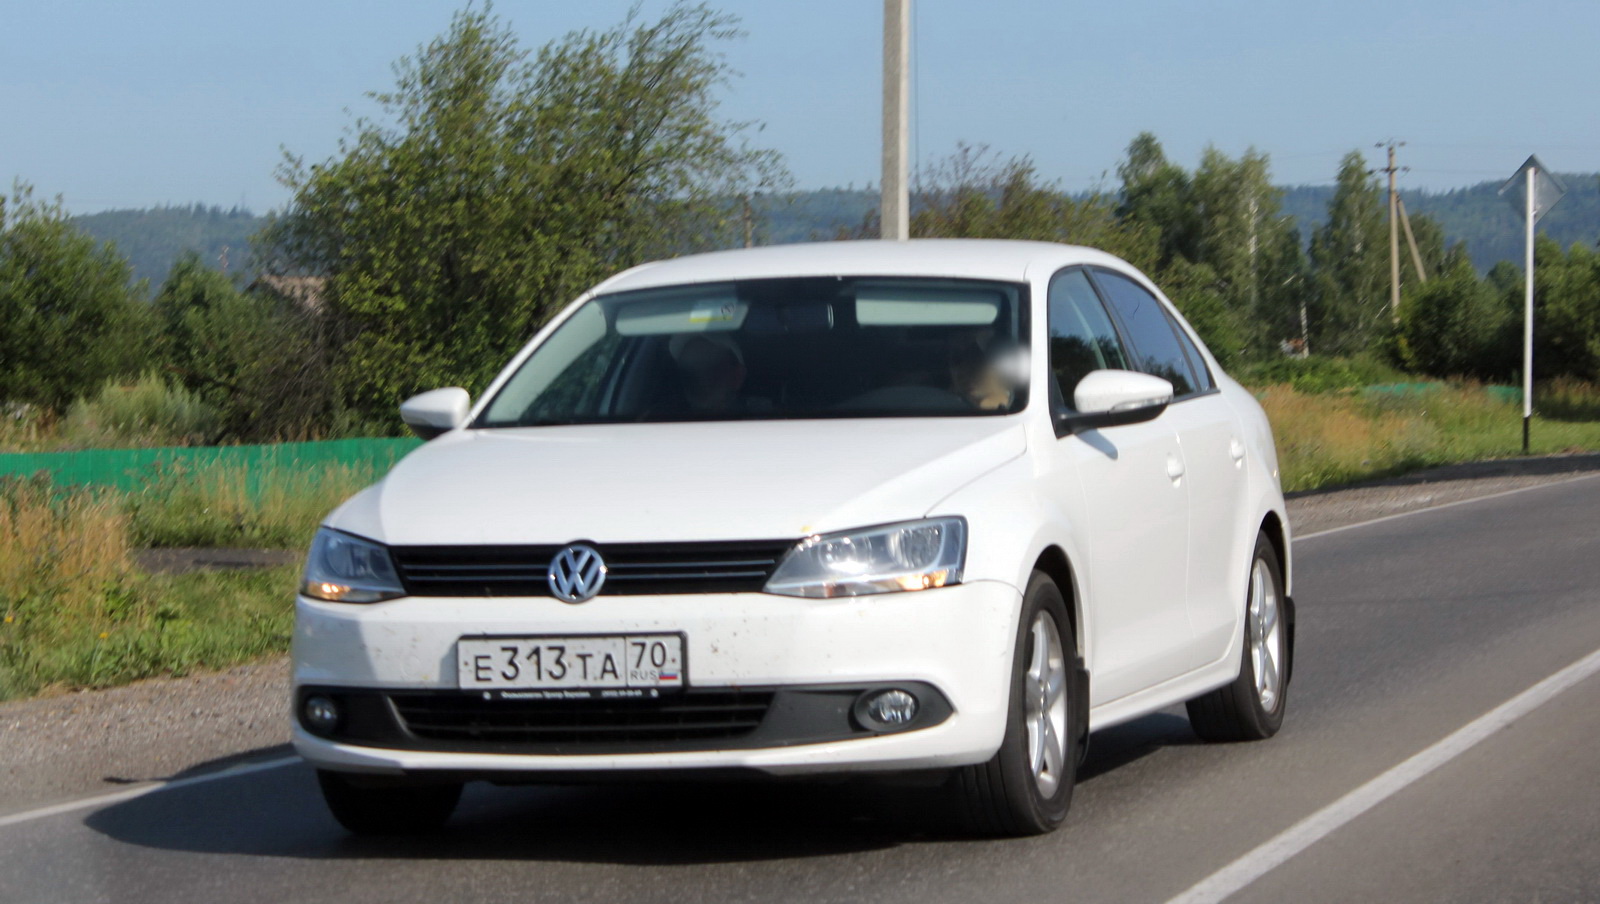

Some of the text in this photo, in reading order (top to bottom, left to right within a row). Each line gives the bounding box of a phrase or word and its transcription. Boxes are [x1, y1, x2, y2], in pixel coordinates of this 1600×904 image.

[549, 545, 606, 602] VW
[631, 641, 667, 669] 70
[630, 670, 658, 680] RUS
